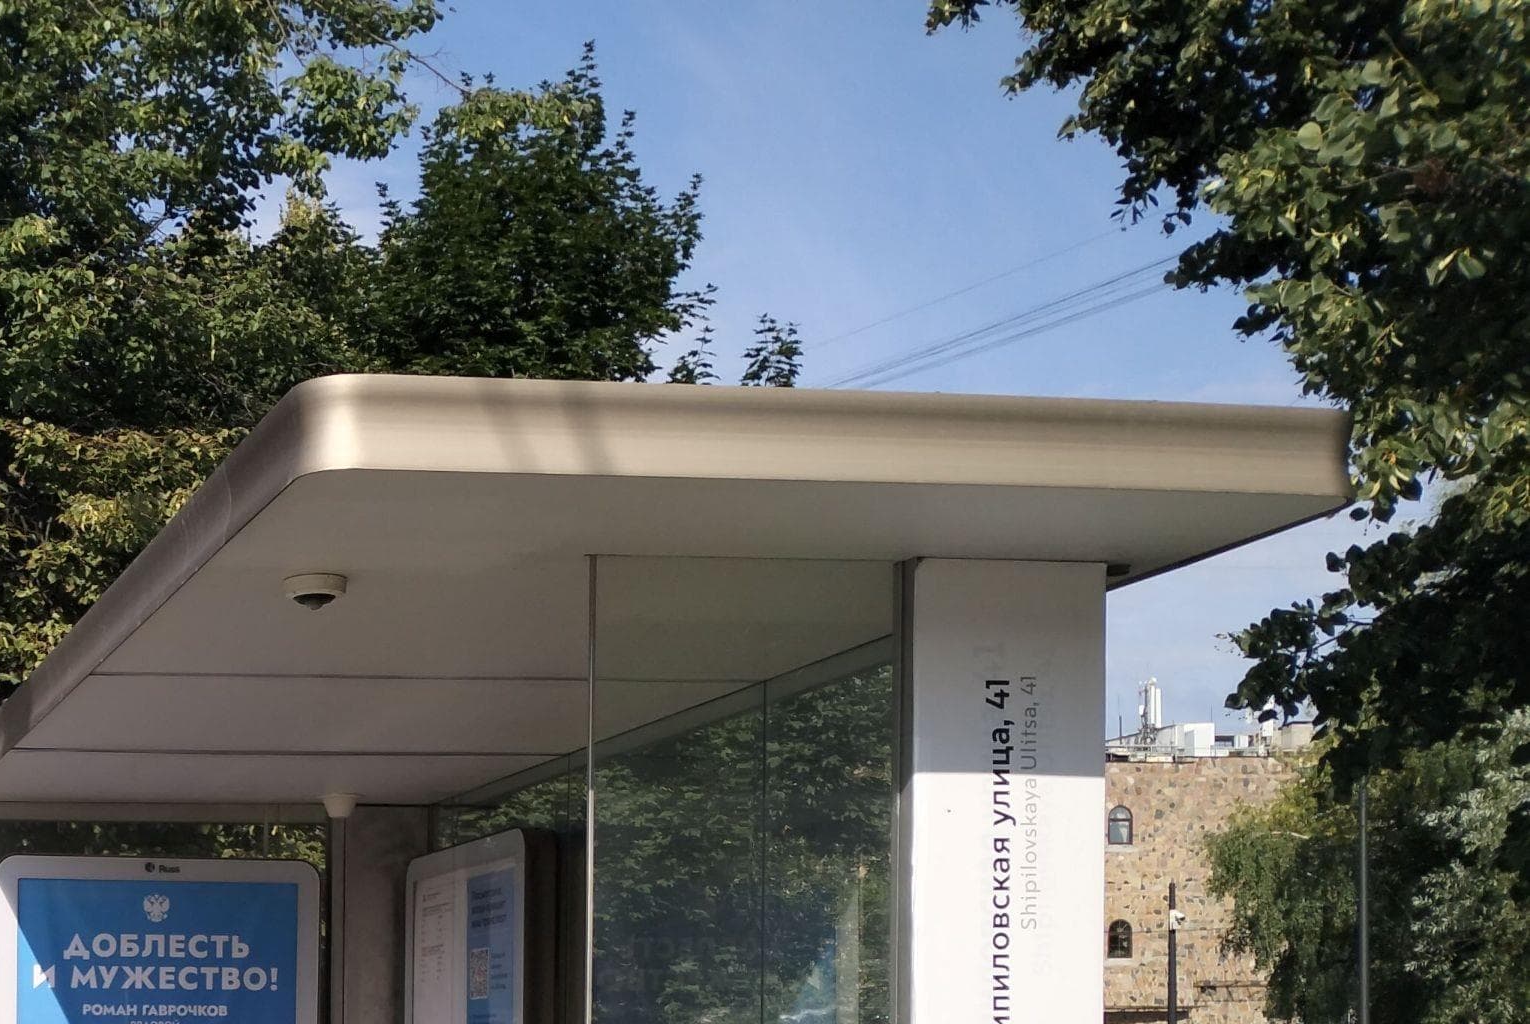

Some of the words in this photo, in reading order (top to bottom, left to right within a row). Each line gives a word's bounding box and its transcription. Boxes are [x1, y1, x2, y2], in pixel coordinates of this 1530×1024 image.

[985, 678, 1010, 710] 41
[1020, 675, 1037, 696] 41
[1020, 702, 1040, 770] Ulitsa,
[991, 720, 1017, 827] улица,
[1020, 778, 1041, 931] Shipilovskaya
[63, 932, 250, 961] ДОБЛЕСТЬ
[32, 964, 57, 989] И
[70, 964, 279, 992] МУЖЕСТВО!
[82, 1003, 138, 1017] РОМАН
[142, 1003, 228, 1018] ГАВРОЧКОВ
